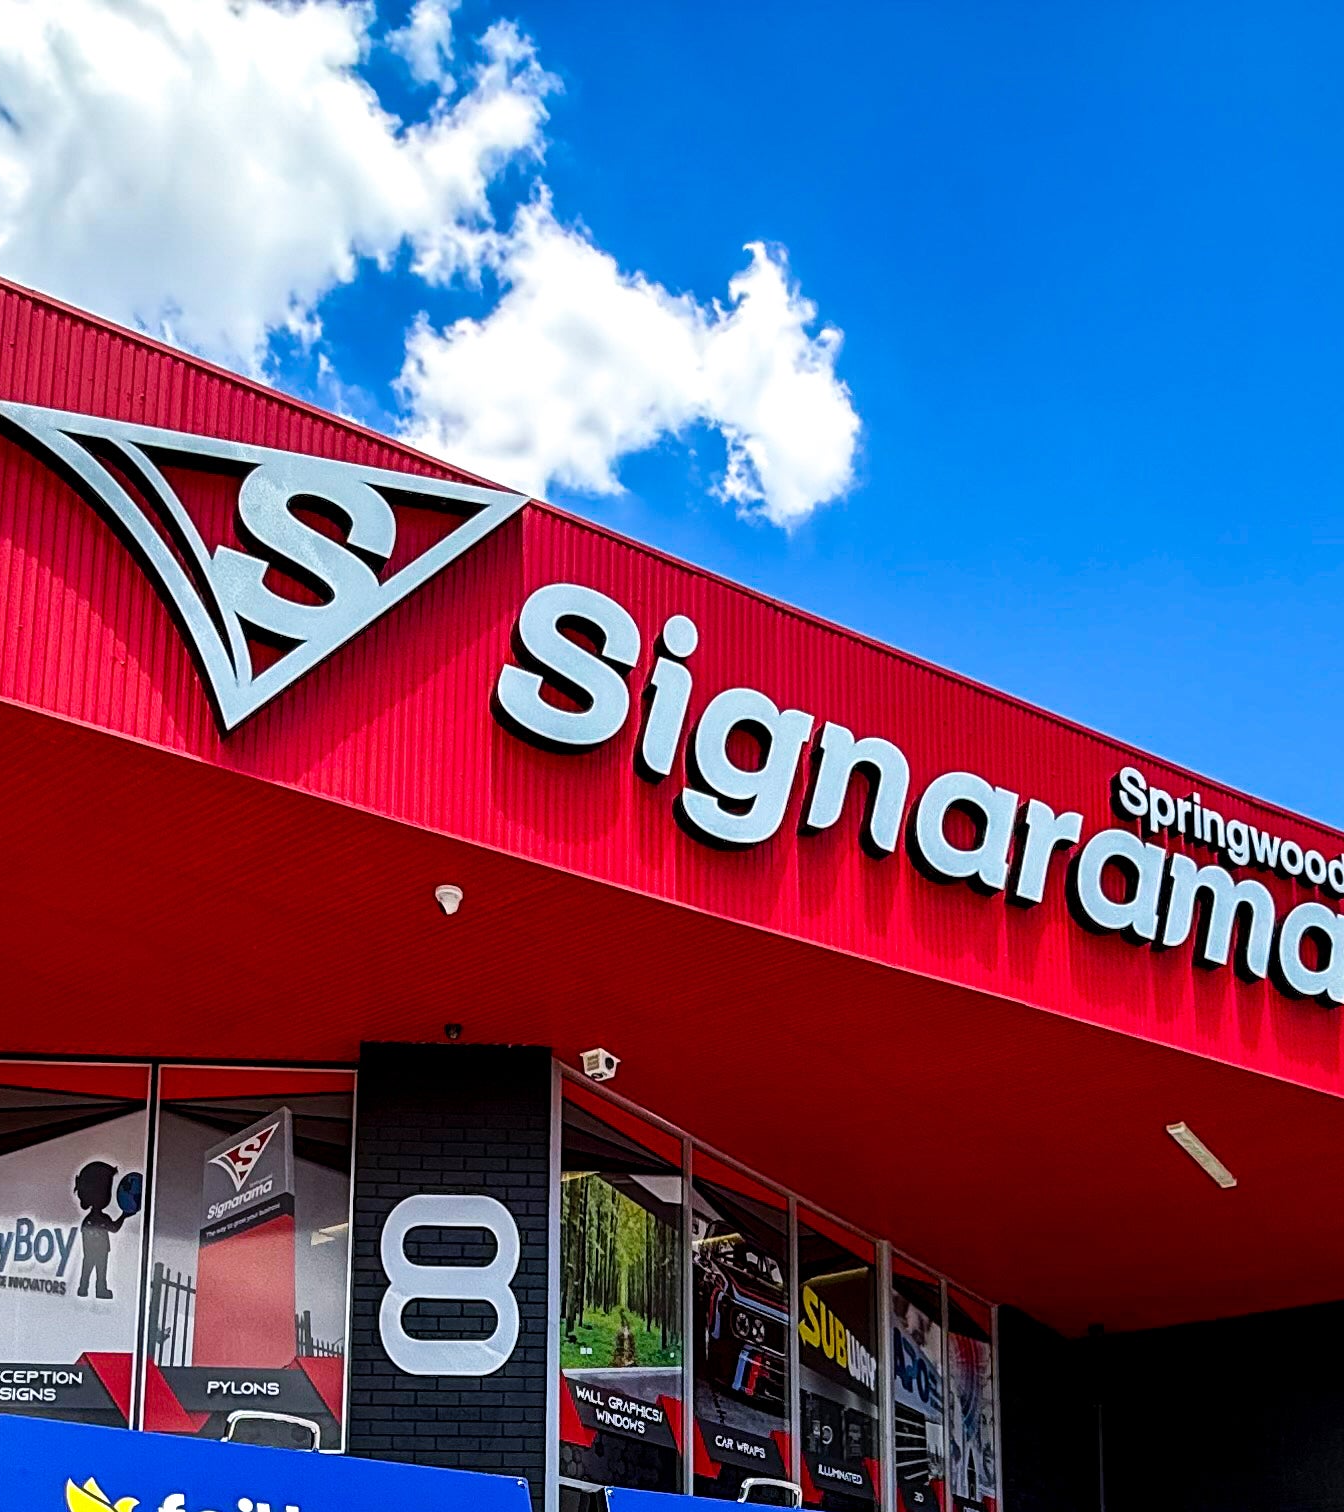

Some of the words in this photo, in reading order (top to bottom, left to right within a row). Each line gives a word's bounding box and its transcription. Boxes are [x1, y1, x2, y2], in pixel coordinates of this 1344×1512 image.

[207, 1180, 273, 1220] Signarama
[378, 1194, 521, 1376] 8
[798, 1286, 877, 1391] SUBWAY
[206, 1380, 280, 1396] PYLONS
[575, 1385, 604, 1407] WALL
[608, 1396, 663, 1423] GRAPHICS/
[596, 1408, 646, 1435] WINDOWS
[715, 1435, 734, 1449] CAR
[736, 1441, 766, 1459] WRAPS
